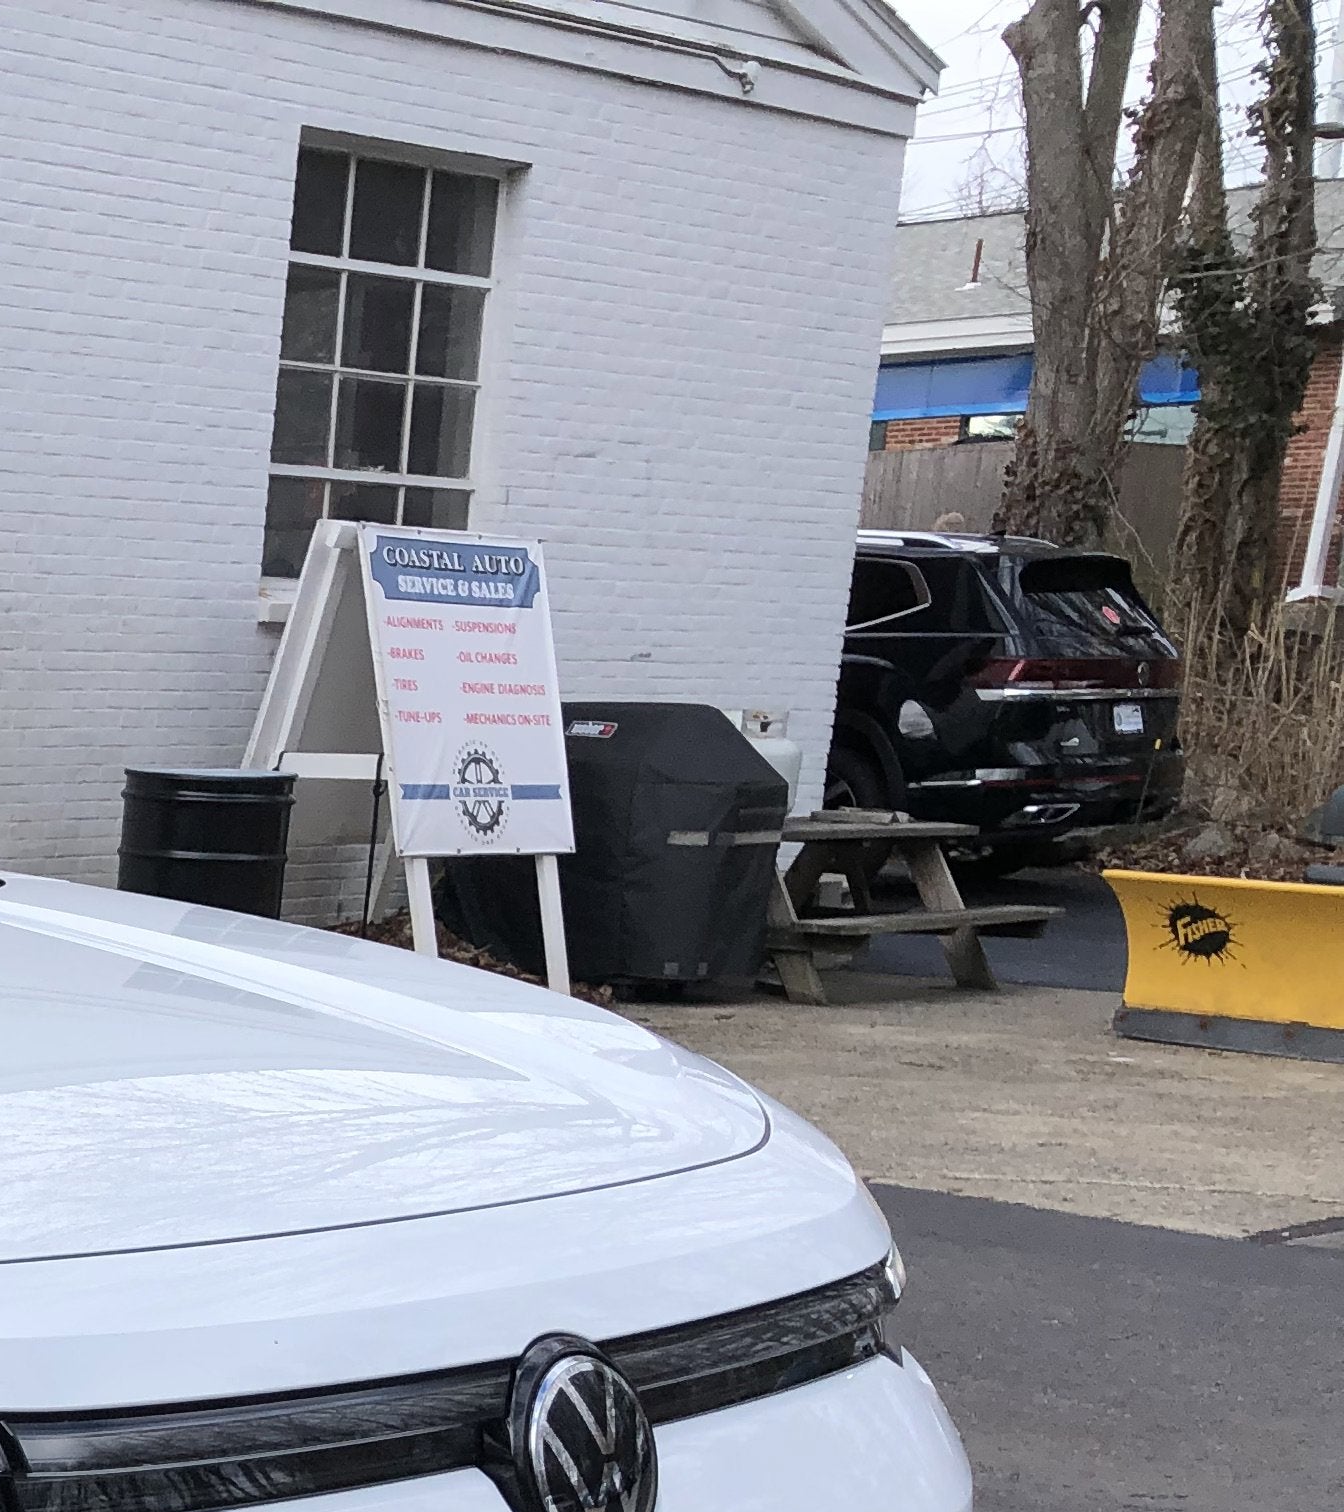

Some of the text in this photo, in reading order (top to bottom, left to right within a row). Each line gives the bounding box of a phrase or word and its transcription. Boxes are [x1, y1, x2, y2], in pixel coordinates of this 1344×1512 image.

[383, 546, 524, 576] COASTAL AUTO
[398, 575, 514, 599] SERVICE & SALES
[387, 647, 424, 660] -BRAKES
[475, 652, 518, 664] CHANGES
[392, 678, 418, 691] -TIRES
[497, 684, 545, 695] DIAGNOSIS
[518, 714, 551, 726] ON-SITE
[453, 786, 509, 797] CAR SERVICE
[1176, 914, 1228, 946] FISHER
